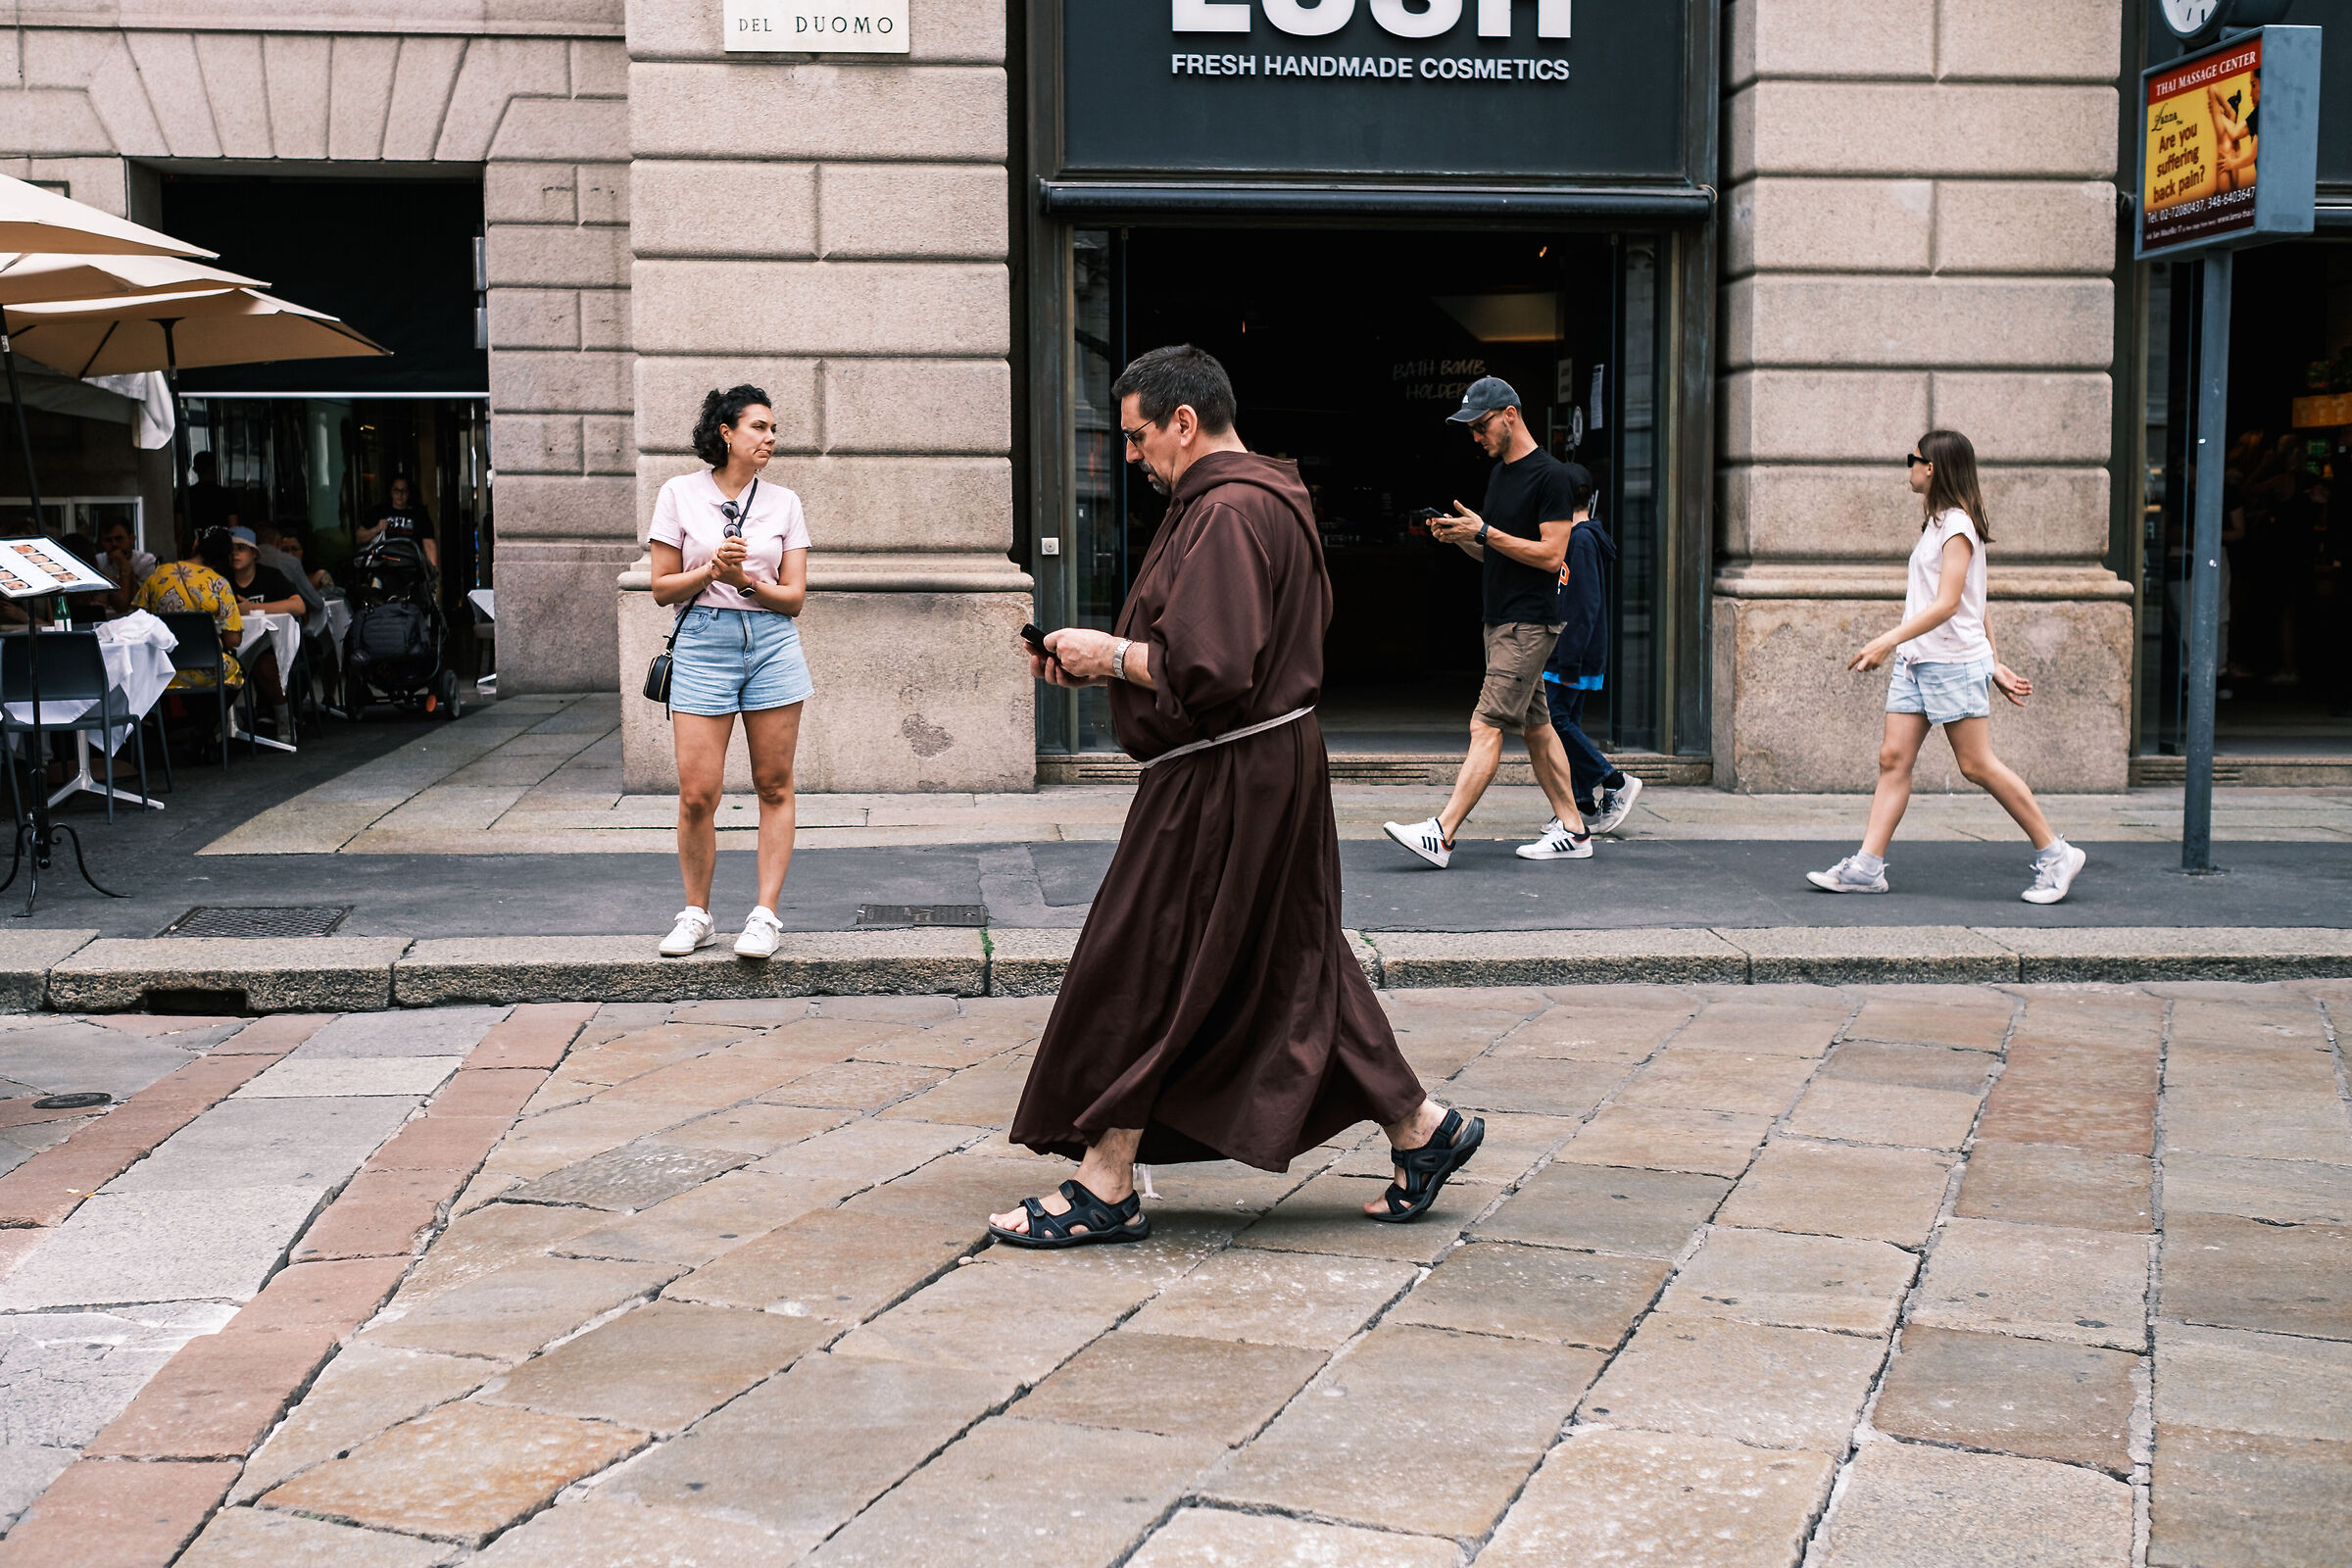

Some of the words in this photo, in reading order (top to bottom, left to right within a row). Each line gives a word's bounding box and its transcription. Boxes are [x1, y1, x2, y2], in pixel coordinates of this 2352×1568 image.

[739, 18, 772, 32] DEL
[796, 16, 894, 33] DUOMO
[1172, 54, 1256, 75] FRESH
[1264, 55, 1413, 78] HANDMADE
[1419, 58, 1570, 80] COSMETICS
[2156, 78, 2177, 96] THAI
[2179, 64, 2218, 89] MASSAGE
[2220, 51, 2256, 74] CENTER
[2159, 135, 2176, 154] Are
[2179, 122, 2197, 147] you
[2157, 146, 2199, 178] suffering
[2153, 178, 2176, 204] back
[2179, 164, 2205, 197] pain?
[1393, 359, 1435, 381] BATH
